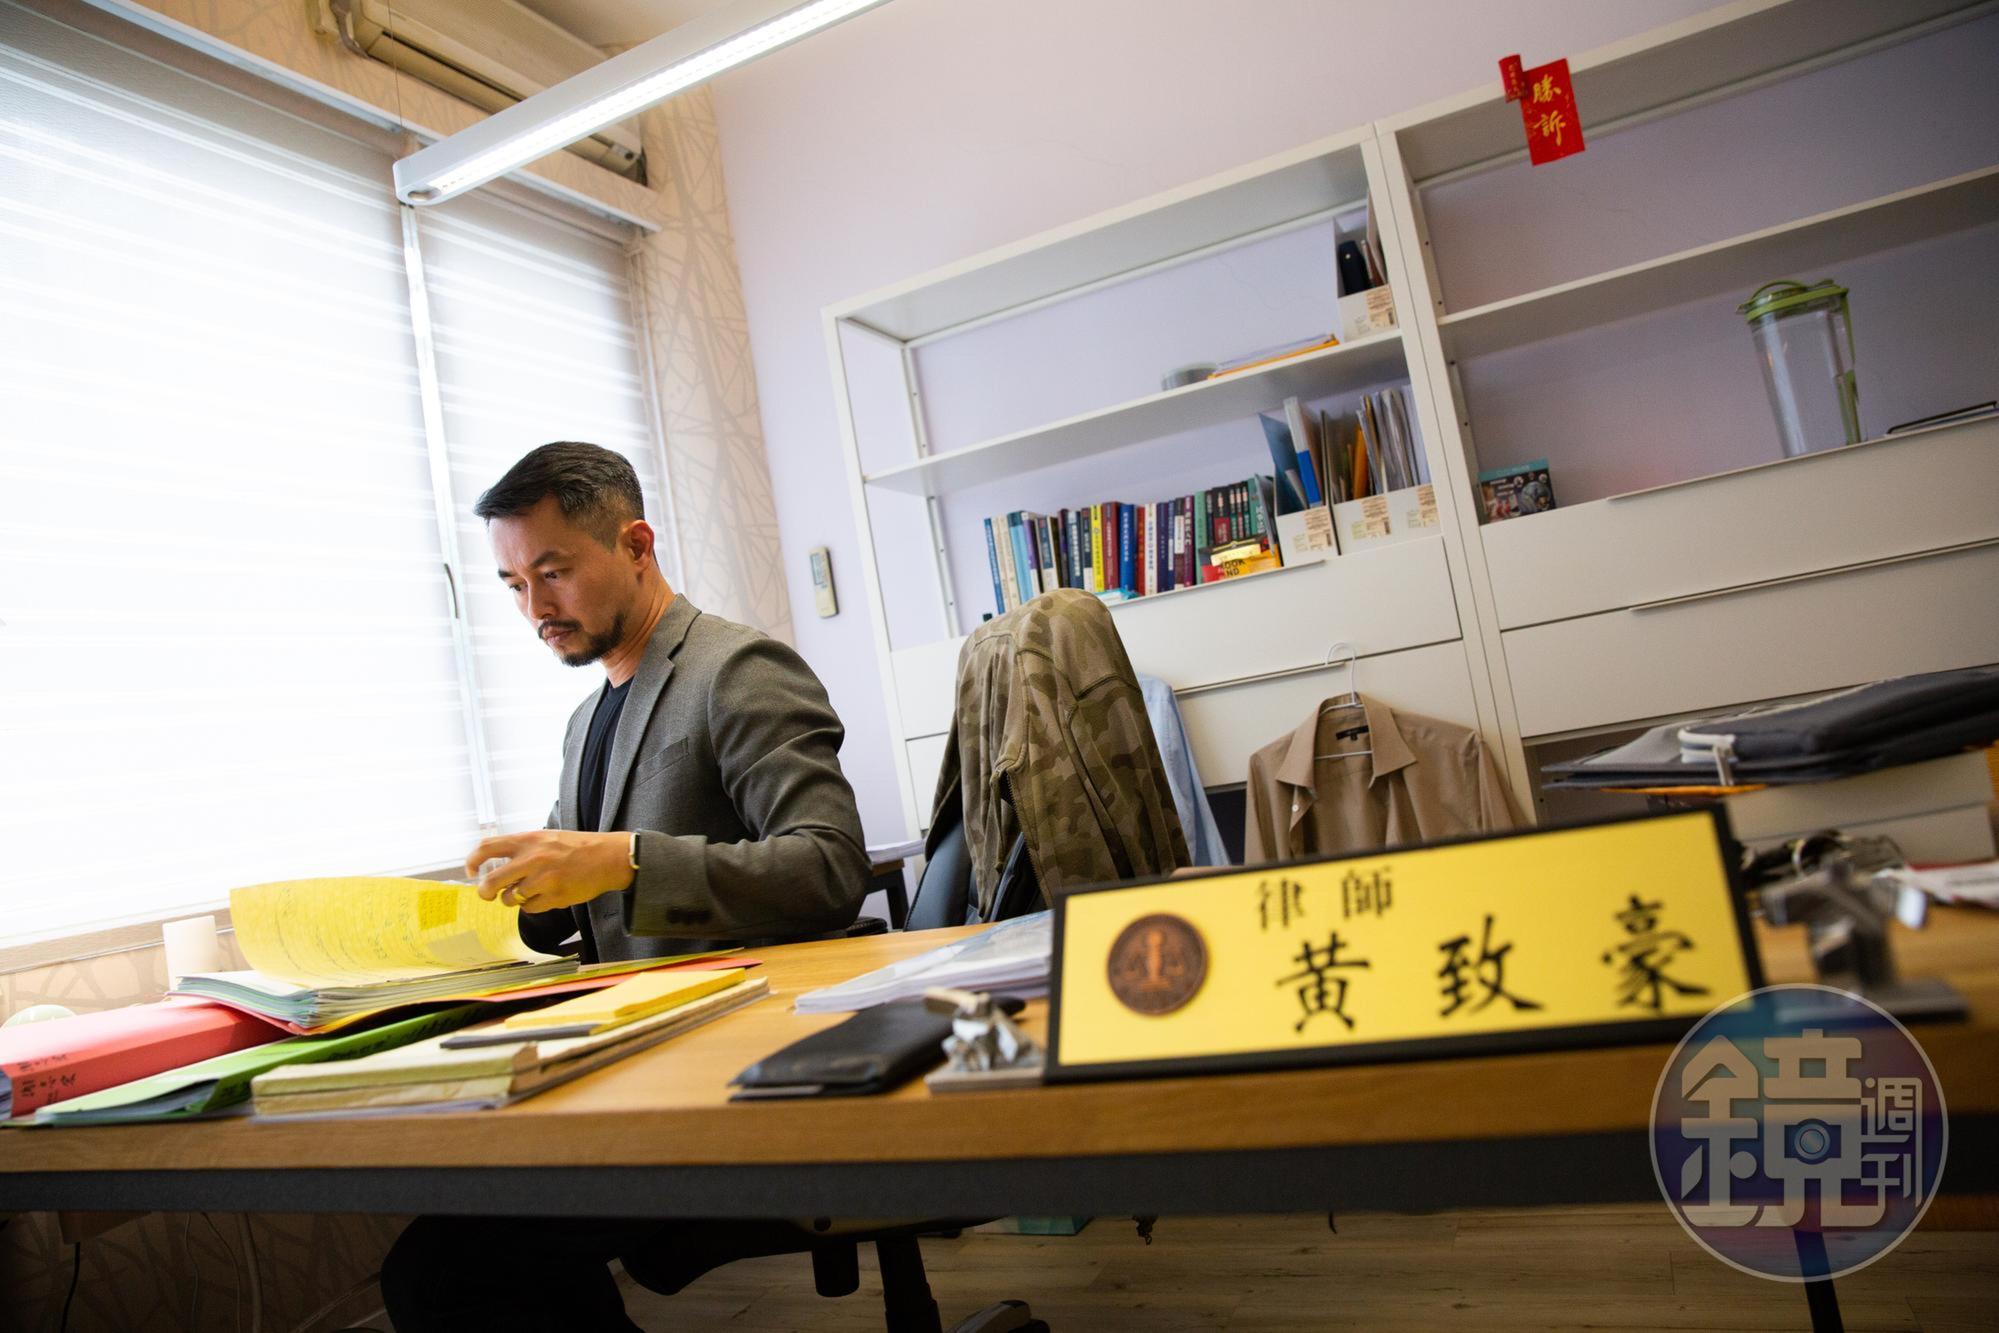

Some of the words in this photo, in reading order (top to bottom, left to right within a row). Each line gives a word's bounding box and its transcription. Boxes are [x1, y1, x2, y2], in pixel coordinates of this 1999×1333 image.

[1532, 73, 1567, 147] 勝訴
[1221, 558, 1246, 570] OOK
[1256, 866, 1393, 931] 律師
[1275, 892, 1712, 1034] 黃致豪
